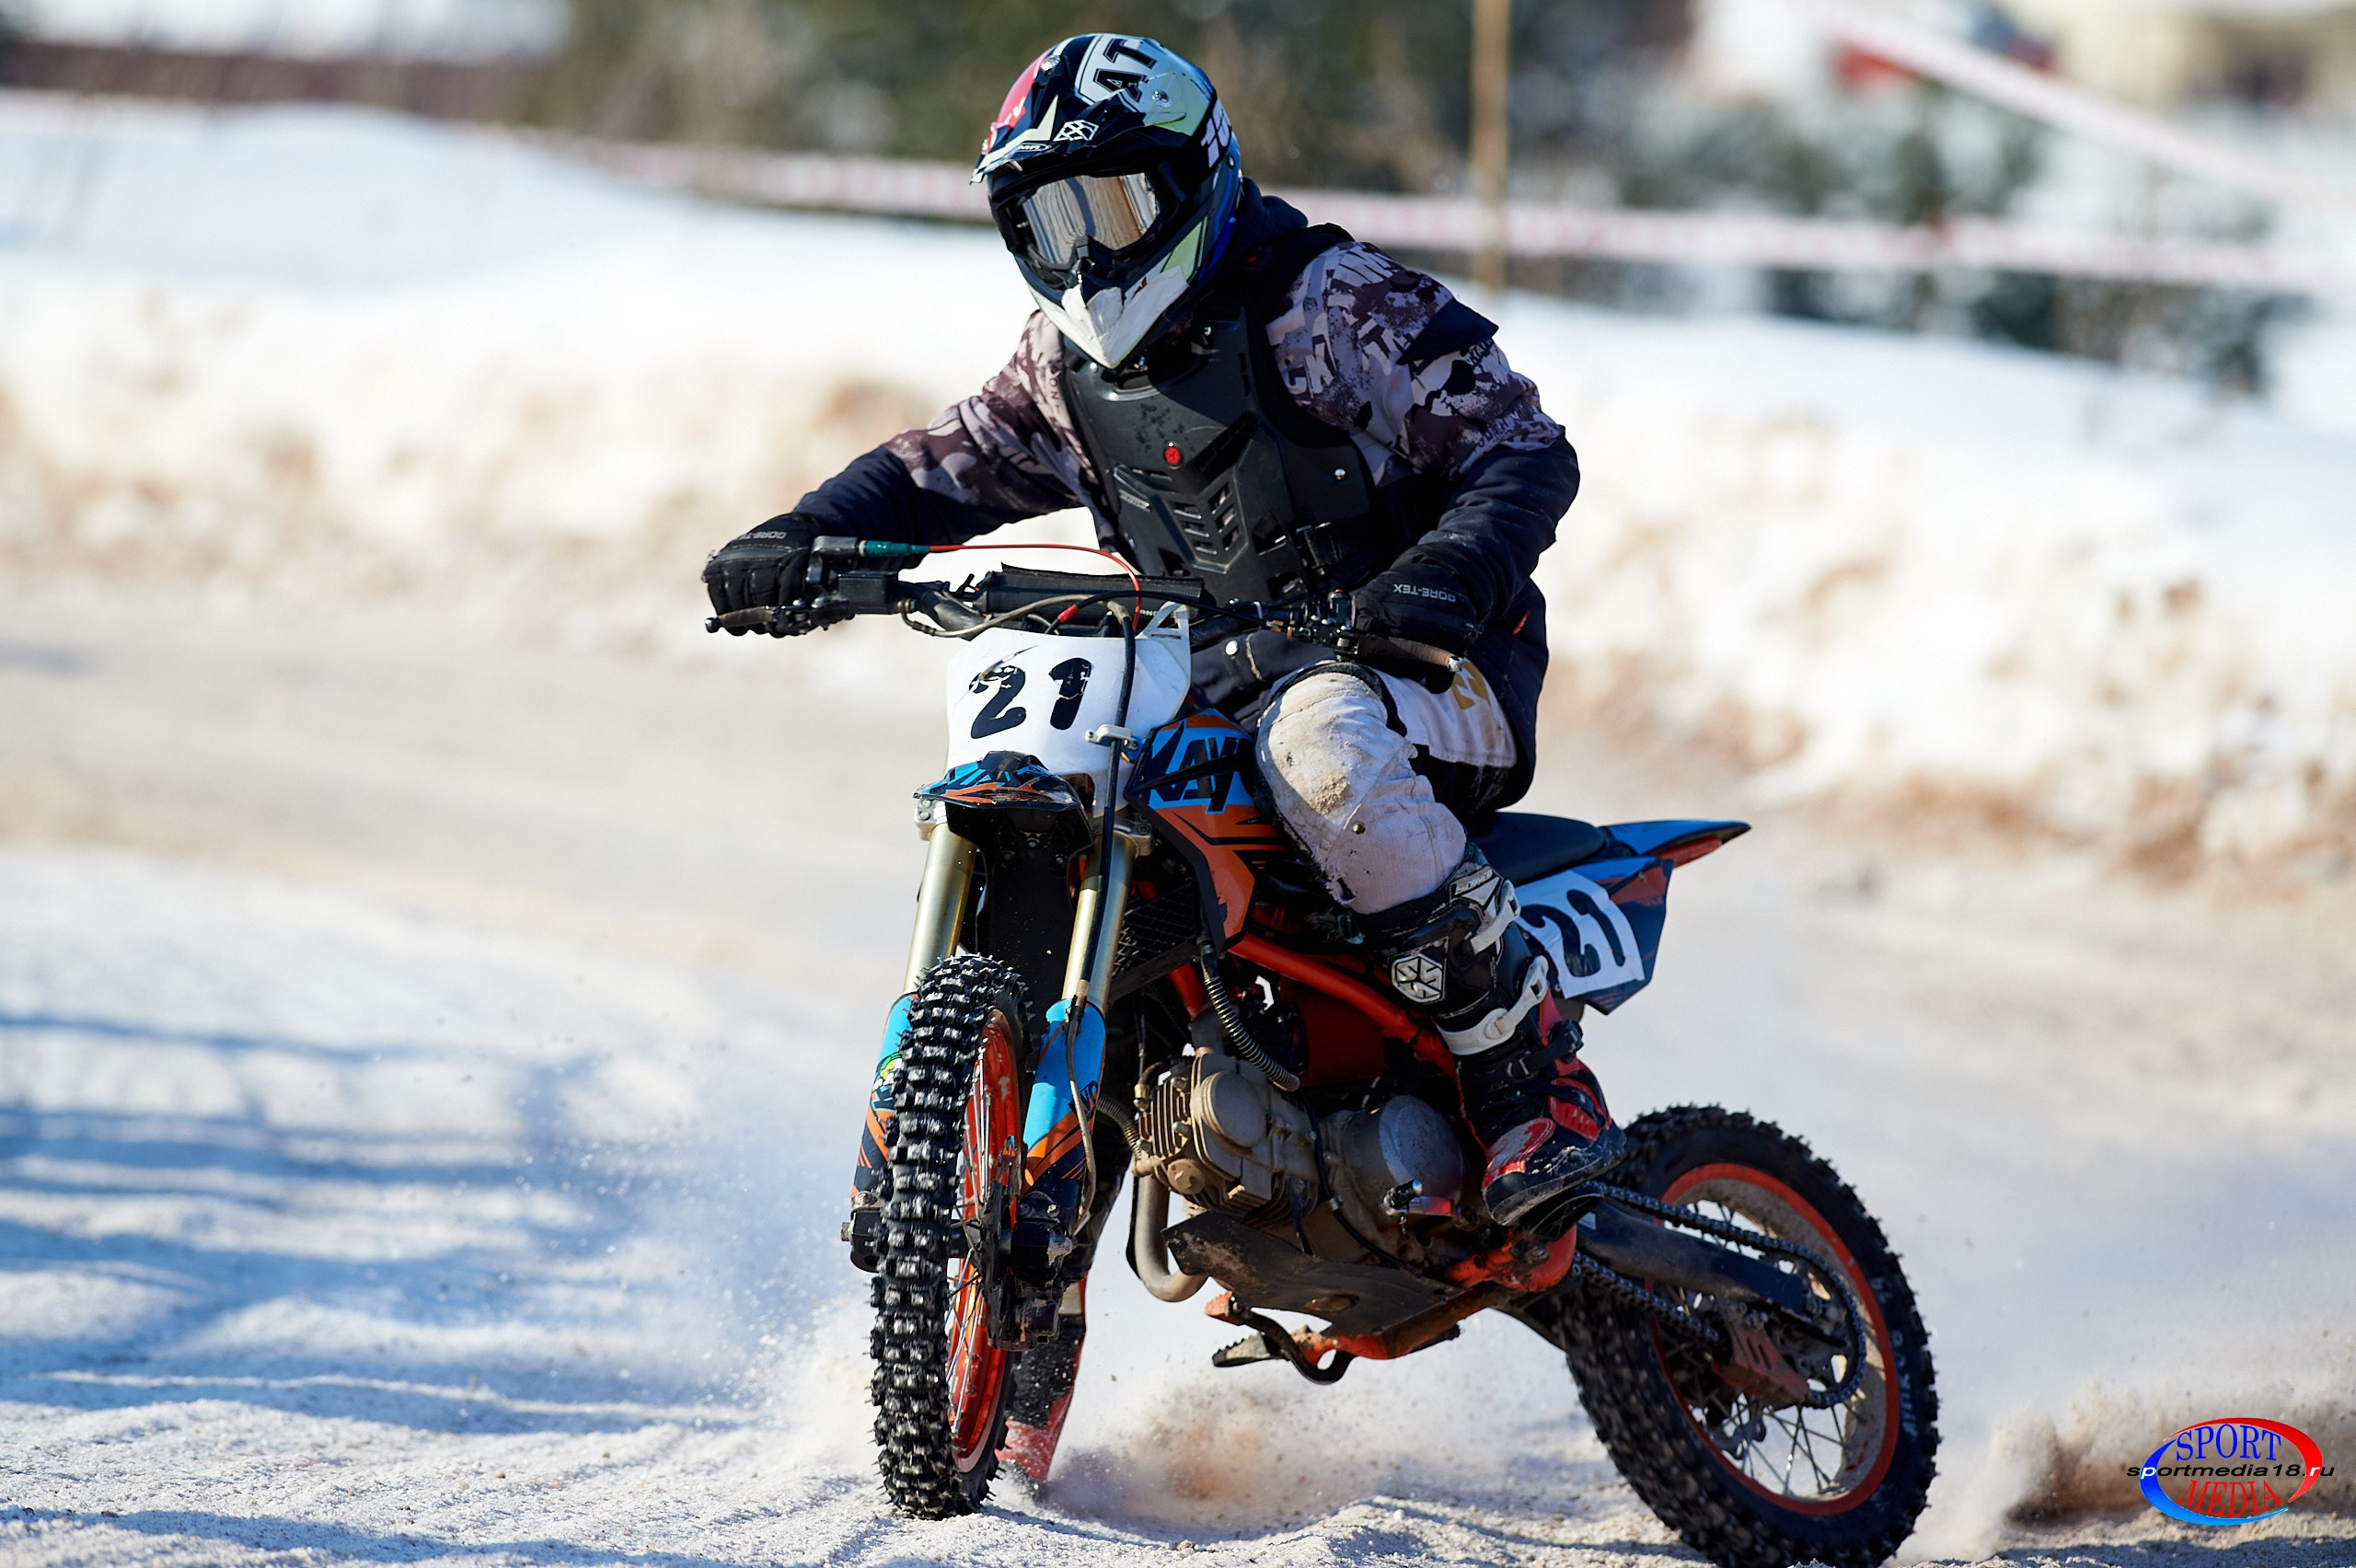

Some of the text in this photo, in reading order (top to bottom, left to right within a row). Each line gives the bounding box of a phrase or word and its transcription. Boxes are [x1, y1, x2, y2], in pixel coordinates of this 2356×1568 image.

[1393, 583, 1456, 603] GORE-TEX
[969, 657, 1092, 739] 21
[1519, 890, 1626, 977] 21
